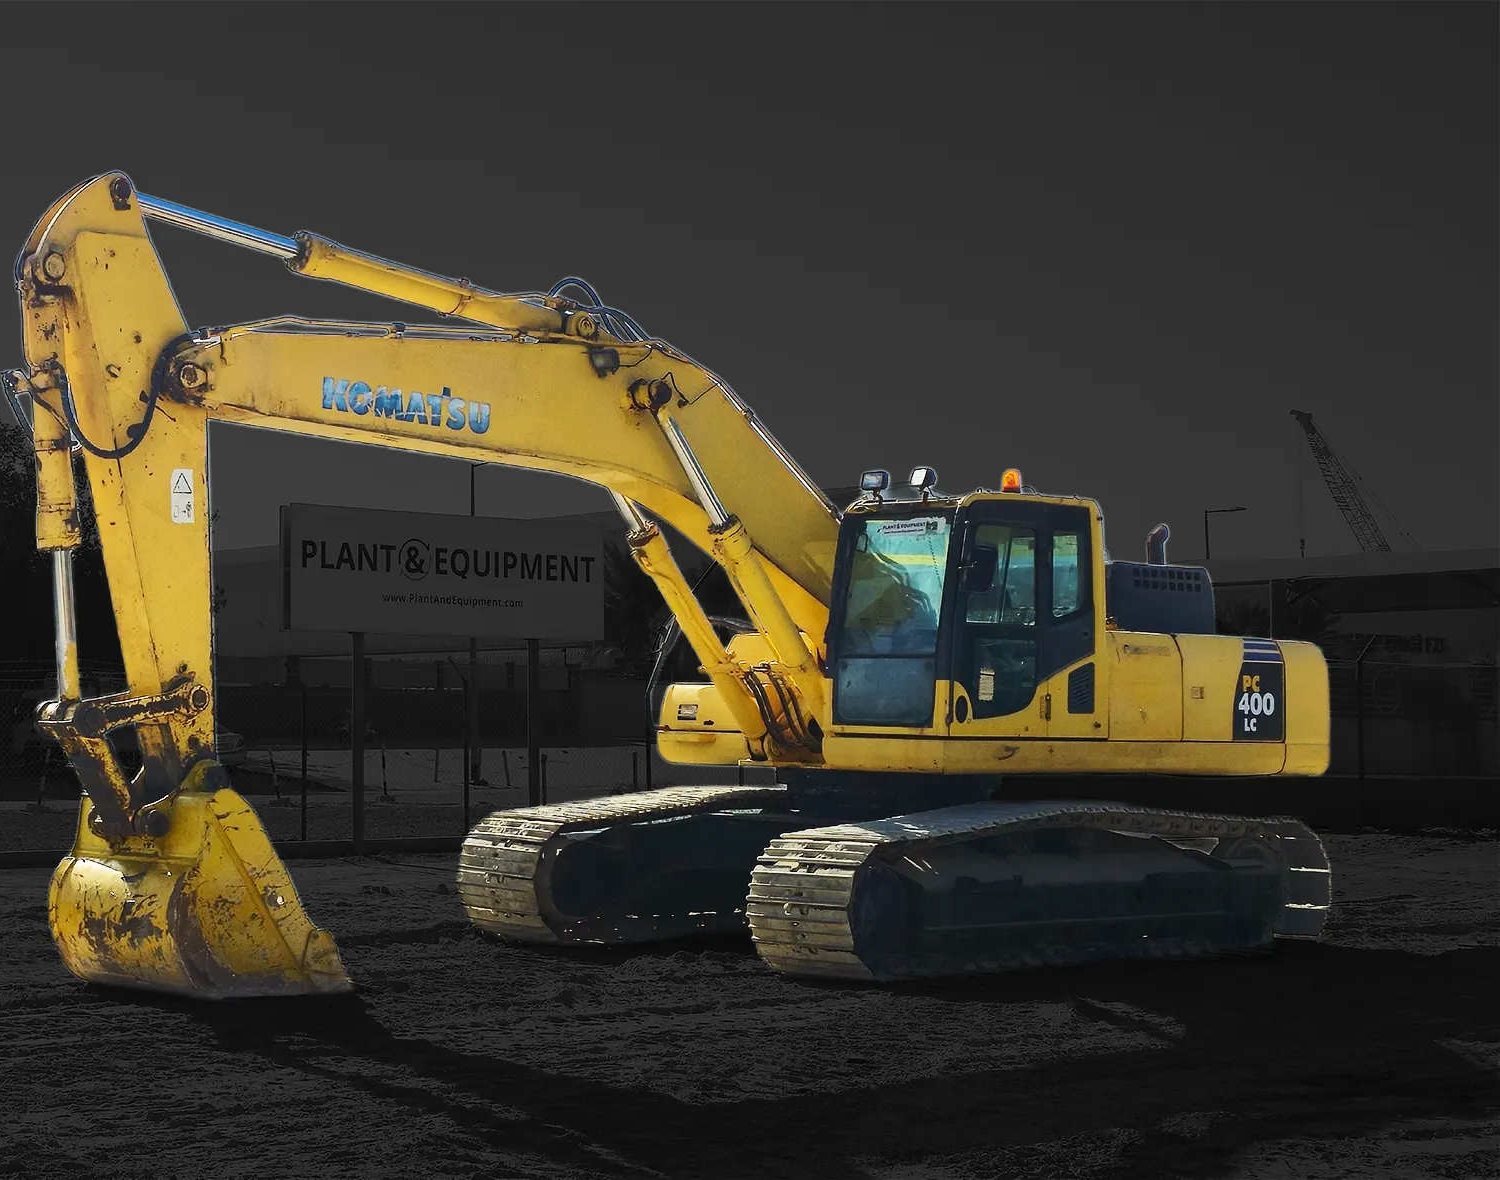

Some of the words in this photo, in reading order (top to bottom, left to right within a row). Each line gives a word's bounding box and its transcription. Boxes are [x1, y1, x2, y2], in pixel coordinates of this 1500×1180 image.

[322, 376, 491, 434] KOMATSU
[301, 540, 396, 572] PLANT
[403, 544, 427, 575] &
[435, 547, 595, 583] EQUIPMENT
[383, 593, 524, 608] www.PlantAndEquipment.com
[1242, 675, 1260, 692] PC
[1238, 692, 1275, 716] 400
[1244, 717, 1257, 732] LC
